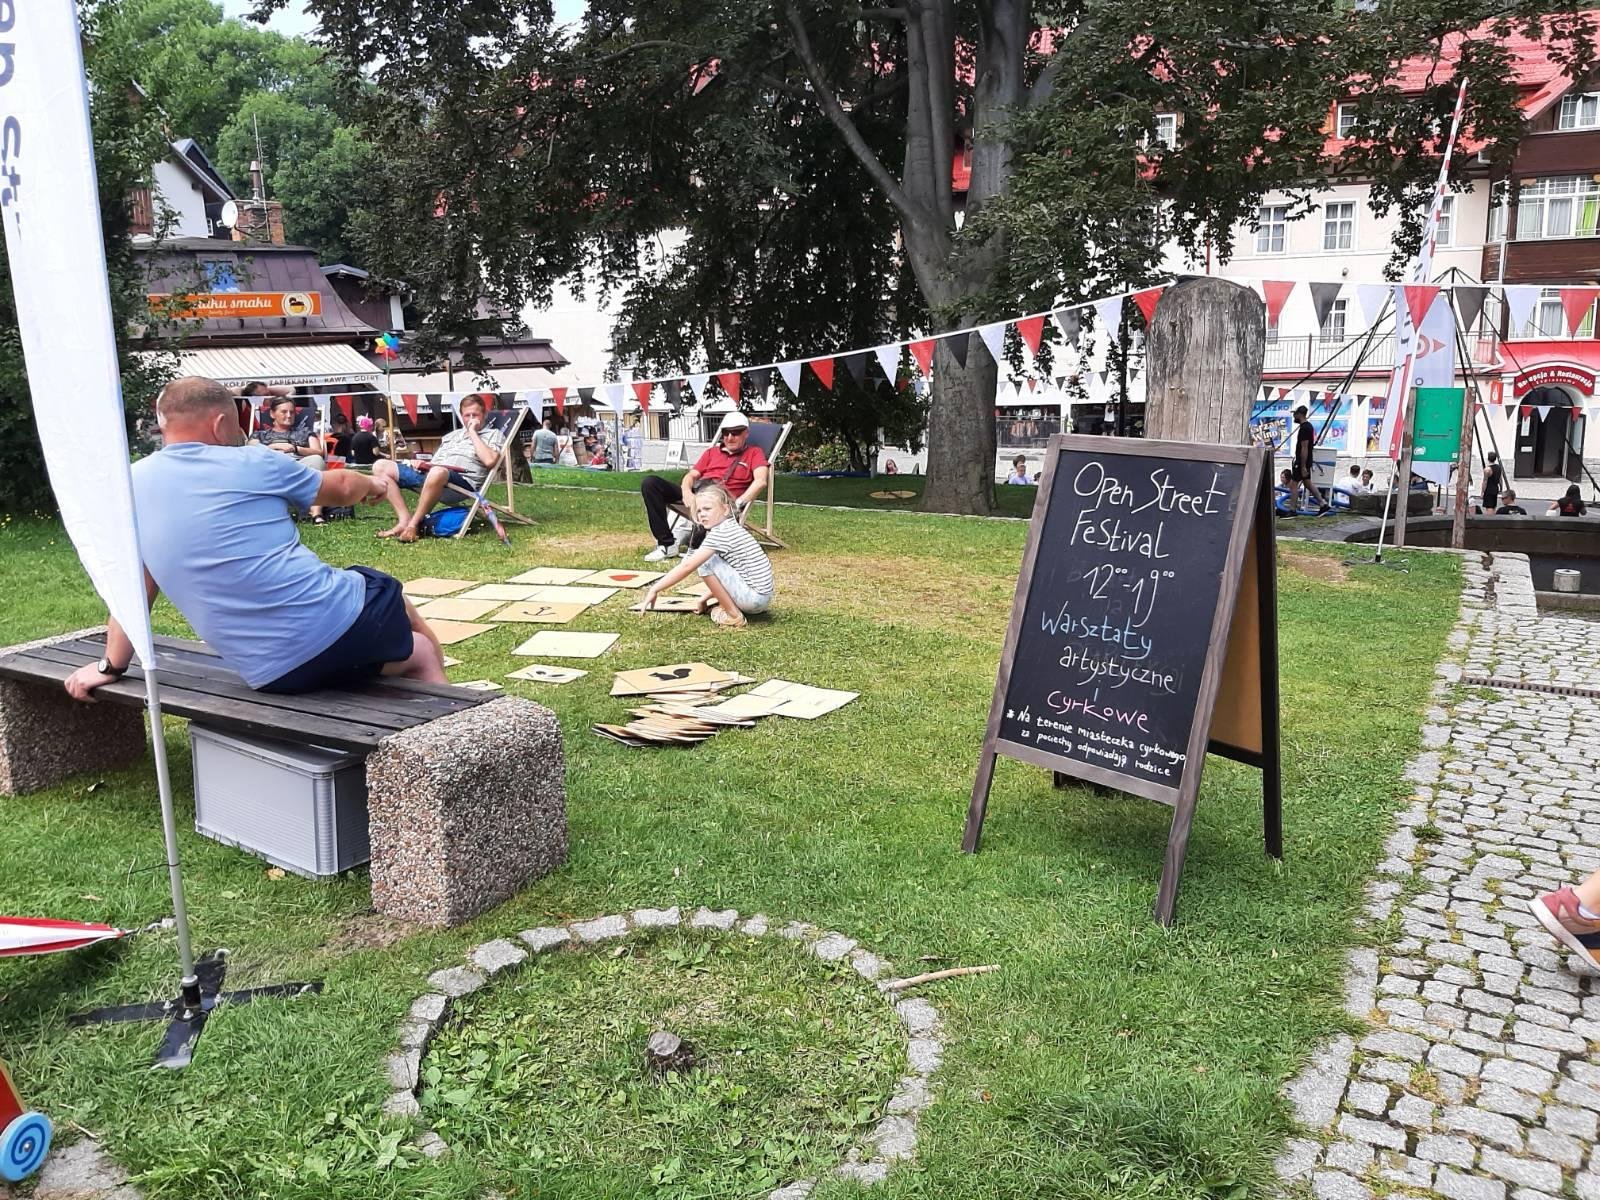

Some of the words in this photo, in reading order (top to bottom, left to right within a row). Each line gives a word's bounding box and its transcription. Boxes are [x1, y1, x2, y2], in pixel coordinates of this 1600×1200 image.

[230, 296, 272, 308] smaku
[269, 378, 317, 386] ZAPIEKANKI
[1557, 370, 1594, 388] Restauracja
[1073, 461, 1134, 509] Open
[1130, 467, 1227, 517] Street
[1070, 508, 1170, 559] Festival
[1041, 600, 1152, 660] Warsztaty
[1059, 645, 1177, 694] artystyczne
[1036, 715, 1073, 734] terenie
[1077, 727, 1135, 749] miasteczka
[1139, 743, 1186, 765] cyrkowego
[1036, 733, 1072, 753] pociechy
[1077, 743, 1127, 768] odpowiadają
[1134, 760, 1171, 777] rodzice
